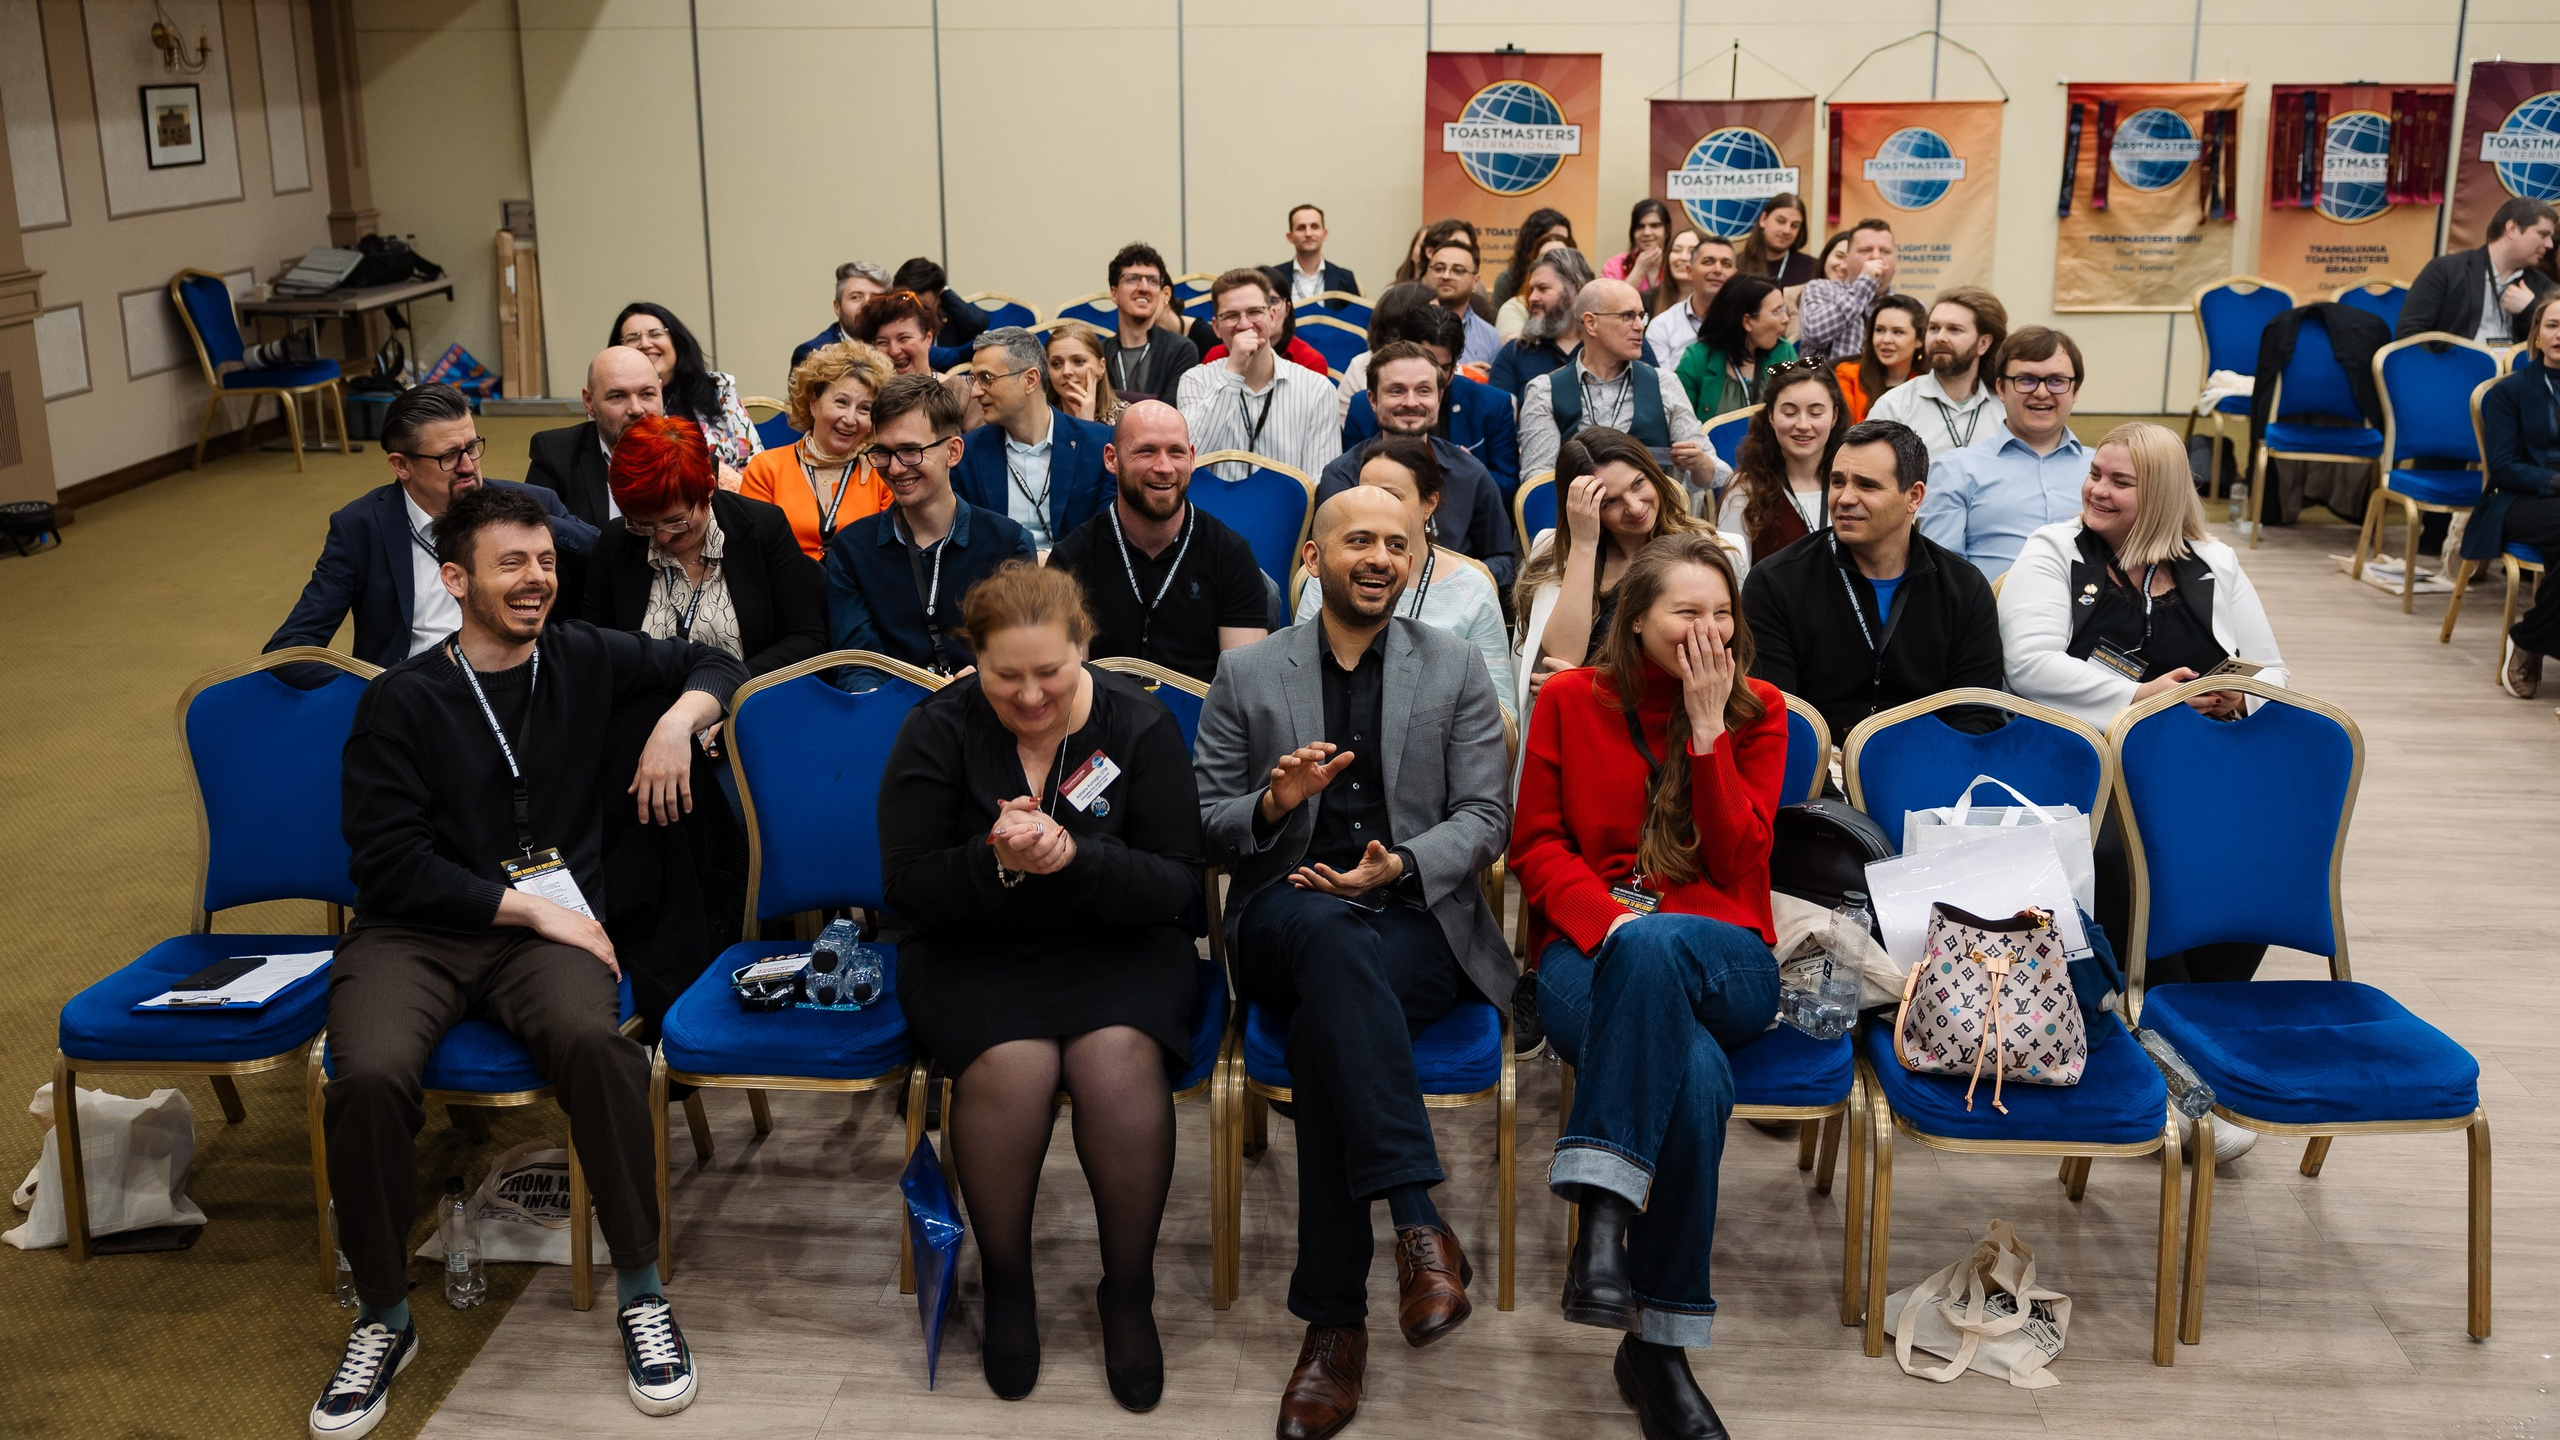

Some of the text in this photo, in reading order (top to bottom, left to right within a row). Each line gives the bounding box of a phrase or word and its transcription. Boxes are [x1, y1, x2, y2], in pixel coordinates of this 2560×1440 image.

[1449, 127, 1575, 140] TOASTMASTERS
[1461, 141, 1560, 150] INTERNATIONAL
[2112, 142, 2200, 150] OASTMASTERS
[2488, 136, 2560, 149] TOASTMA
[2500, 150, 2560, 159] INTERNAT
[1868, 162, 1961, 170] TOASTMASTERS
[2327, 158, 2387, 168] STMAST
[1672, 172, 1794, 186] TOASTMASTERS
[2305, 255, 2390, 264] TOASTMASTERS
[472, 680, 485, 699] DIVISION
[483, 703, 500, 731] CONFERENCE
[522, 1193, 570, 1209] INFLU
